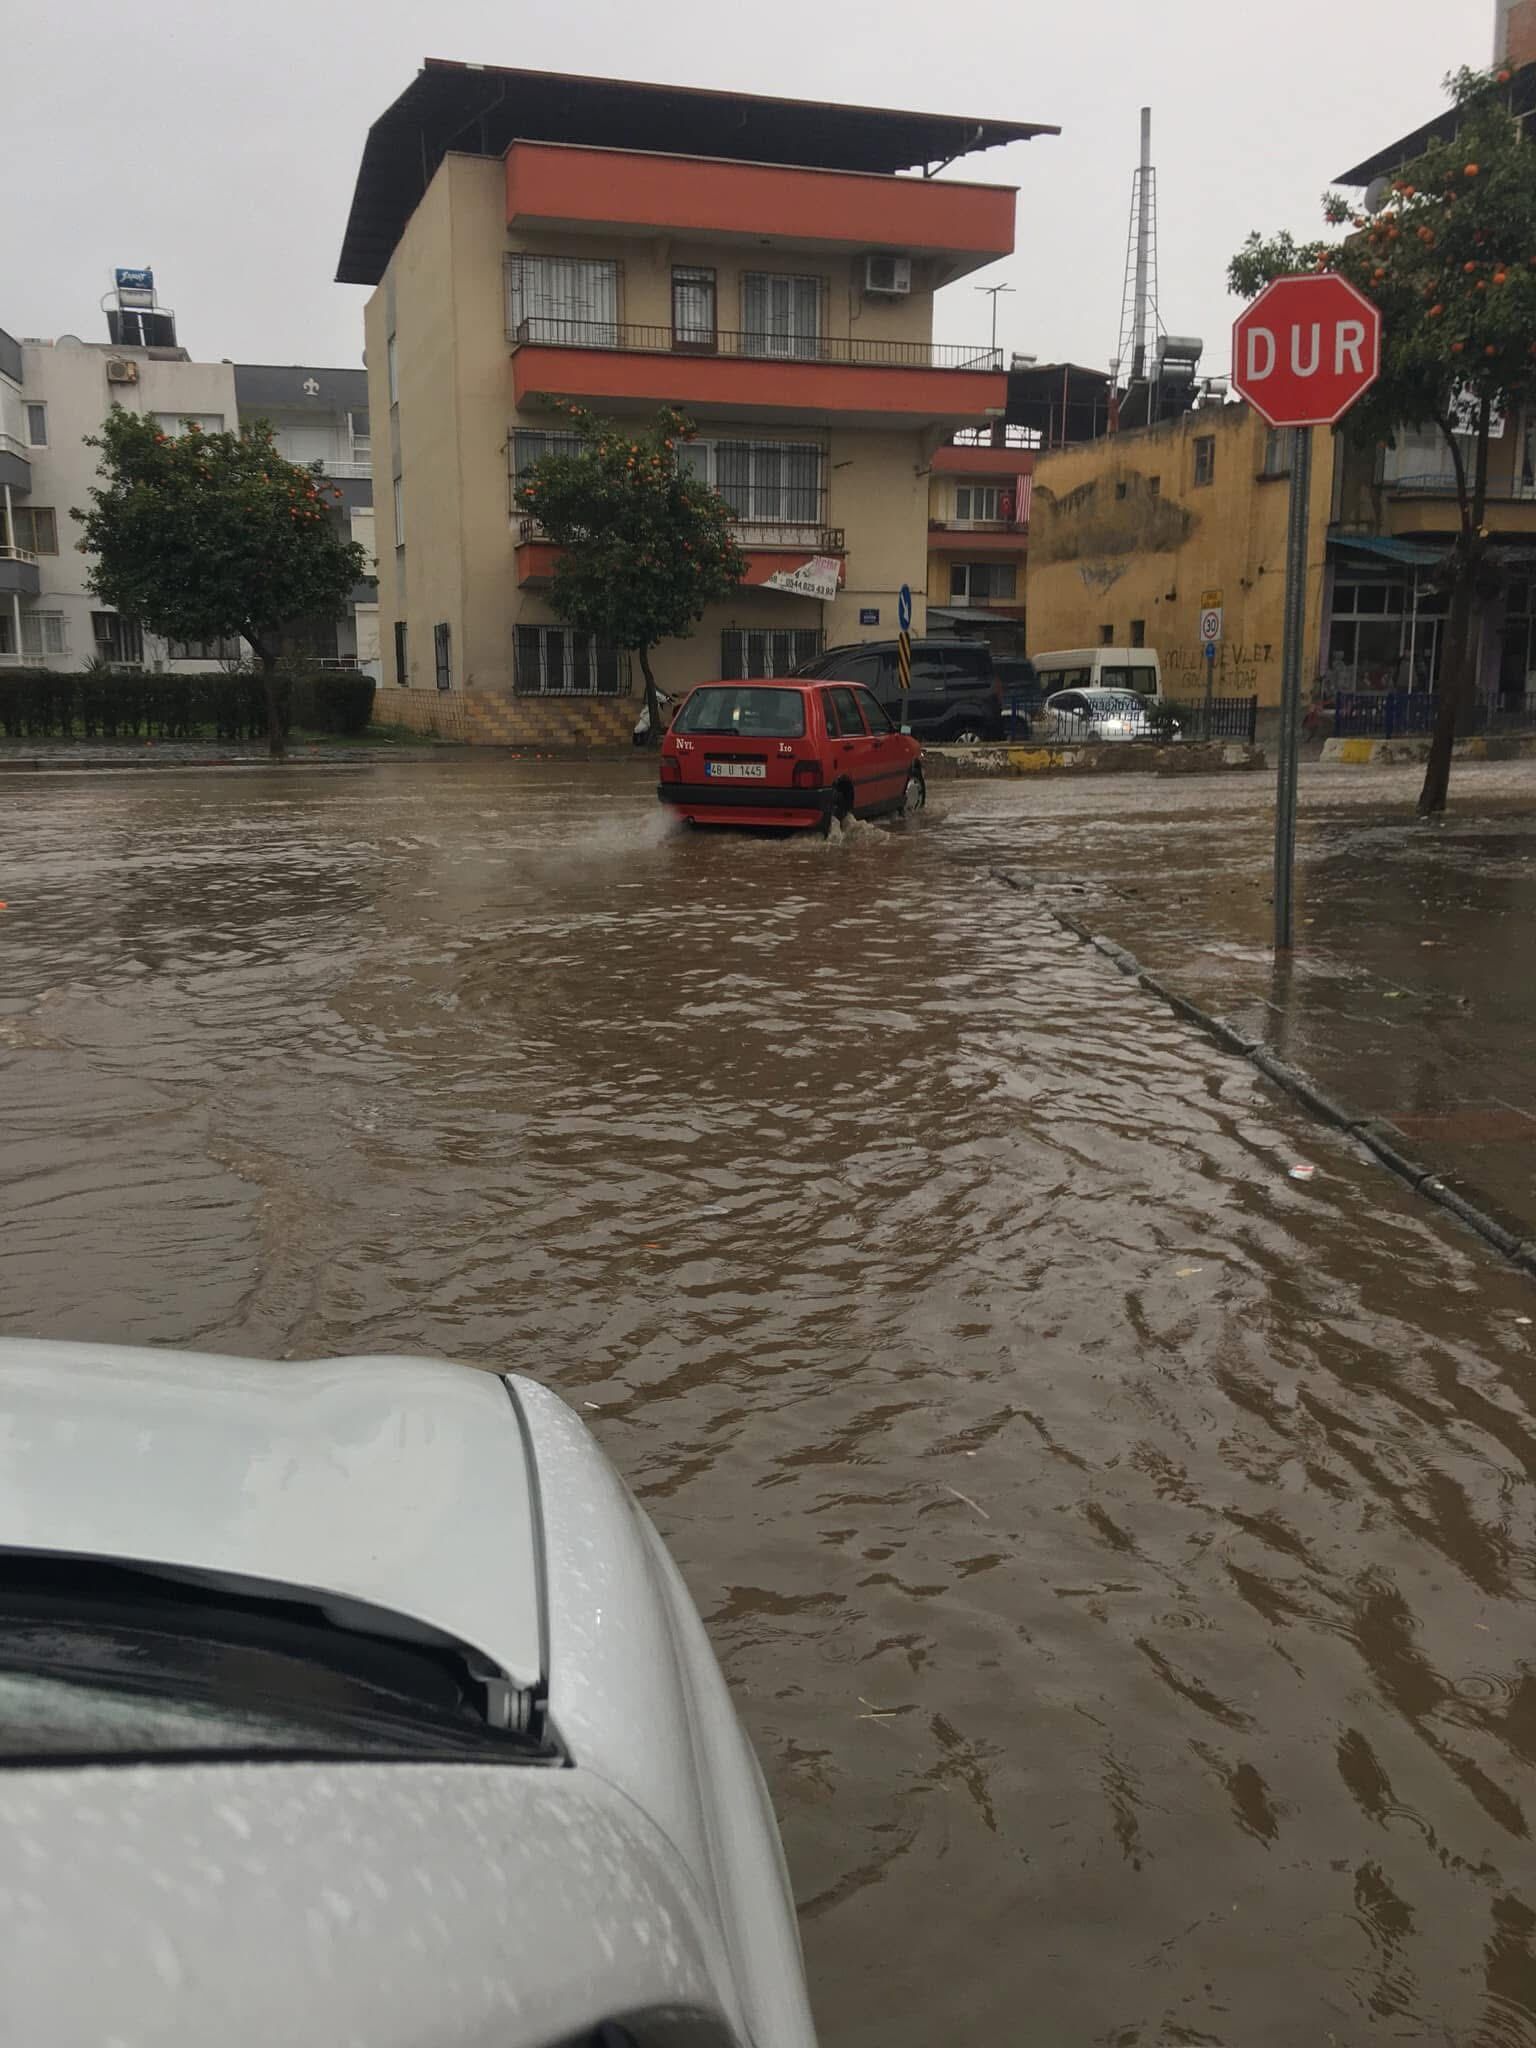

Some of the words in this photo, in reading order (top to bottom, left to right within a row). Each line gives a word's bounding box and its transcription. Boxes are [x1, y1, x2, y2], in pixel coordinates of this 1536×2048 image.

[1246, 320, 1366, 381] DUR
[1206, 619, 1216, 632] 30
[711, 764, 722, 775] 48
[728, 765, 734, 775] U
[740, 766, 762, 776] 1445
